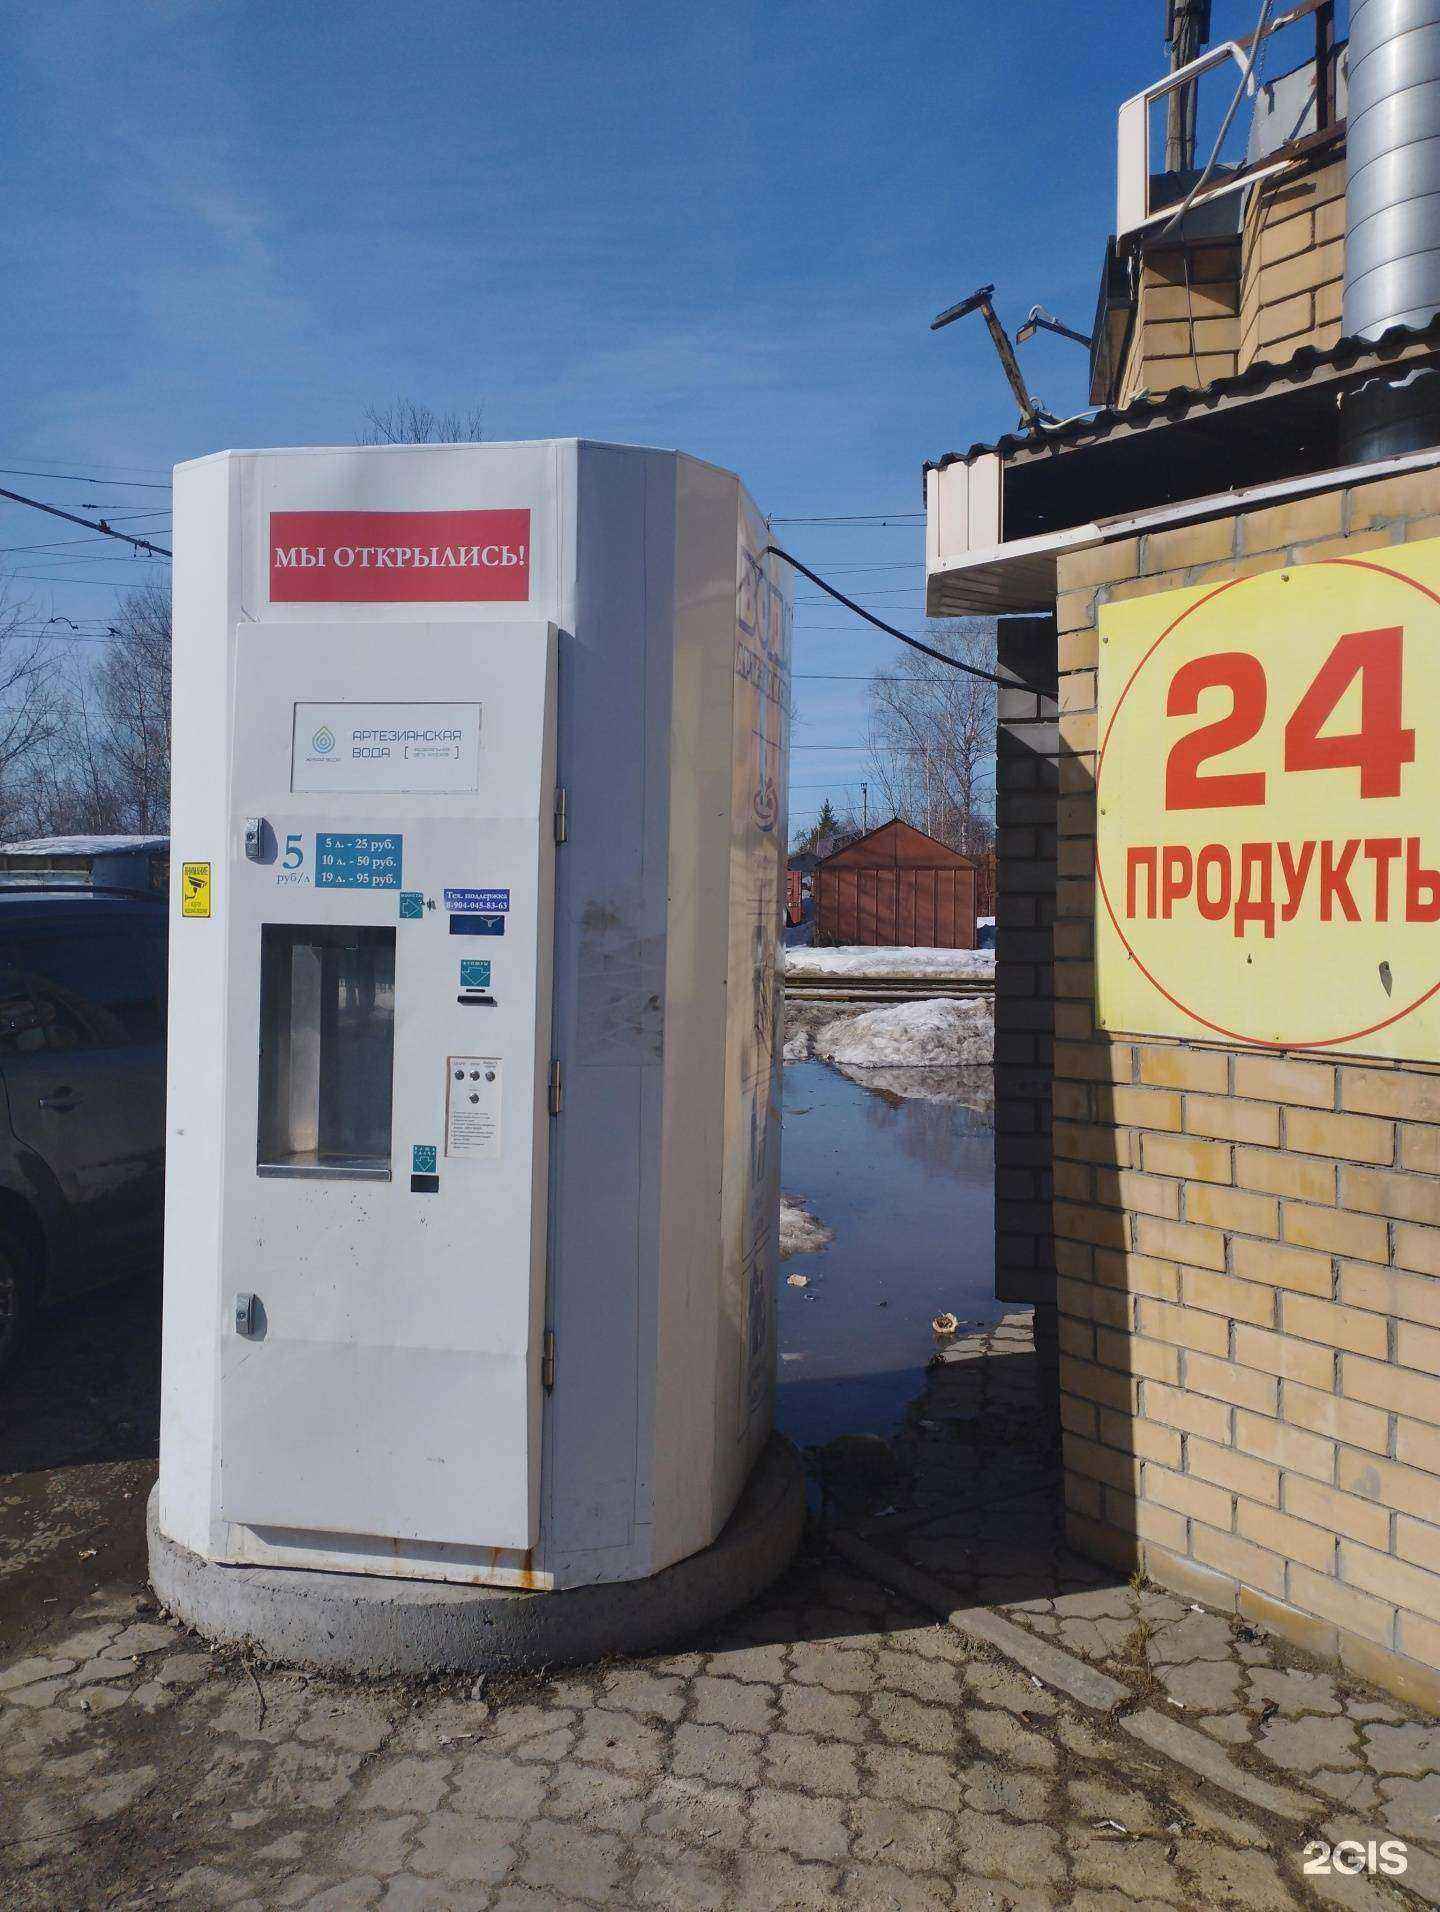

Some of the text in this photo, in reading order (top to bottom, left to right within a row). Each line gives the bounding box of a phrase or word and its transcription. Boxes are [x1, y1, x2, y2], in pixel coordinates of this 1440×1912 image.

[274, 544, 527, 568] МЫ ОТКРЫЛИСЬ!
[1164, 624, 1416, 812] 24
[352, 729, 463, 742] АРТЕЗИАНСКАЯ
[352, 746, 391, 759] ВОДА
[281, 833, 305, 870] 5
[324, 838, 333, 849] 5
[354, 838, 369, 850] 25
[370, 838, 396, 852] руб.
[321, 854, 334, 866] 10
[356, 855, 370, 867] 50
[371, 856, 397, 869] руб.
[276, 872, 311, 885] руб/л
[321, 872, 334, 883] 19
[356, 873, 369, 884] 95
[371, 874, 397, 887] руб.
